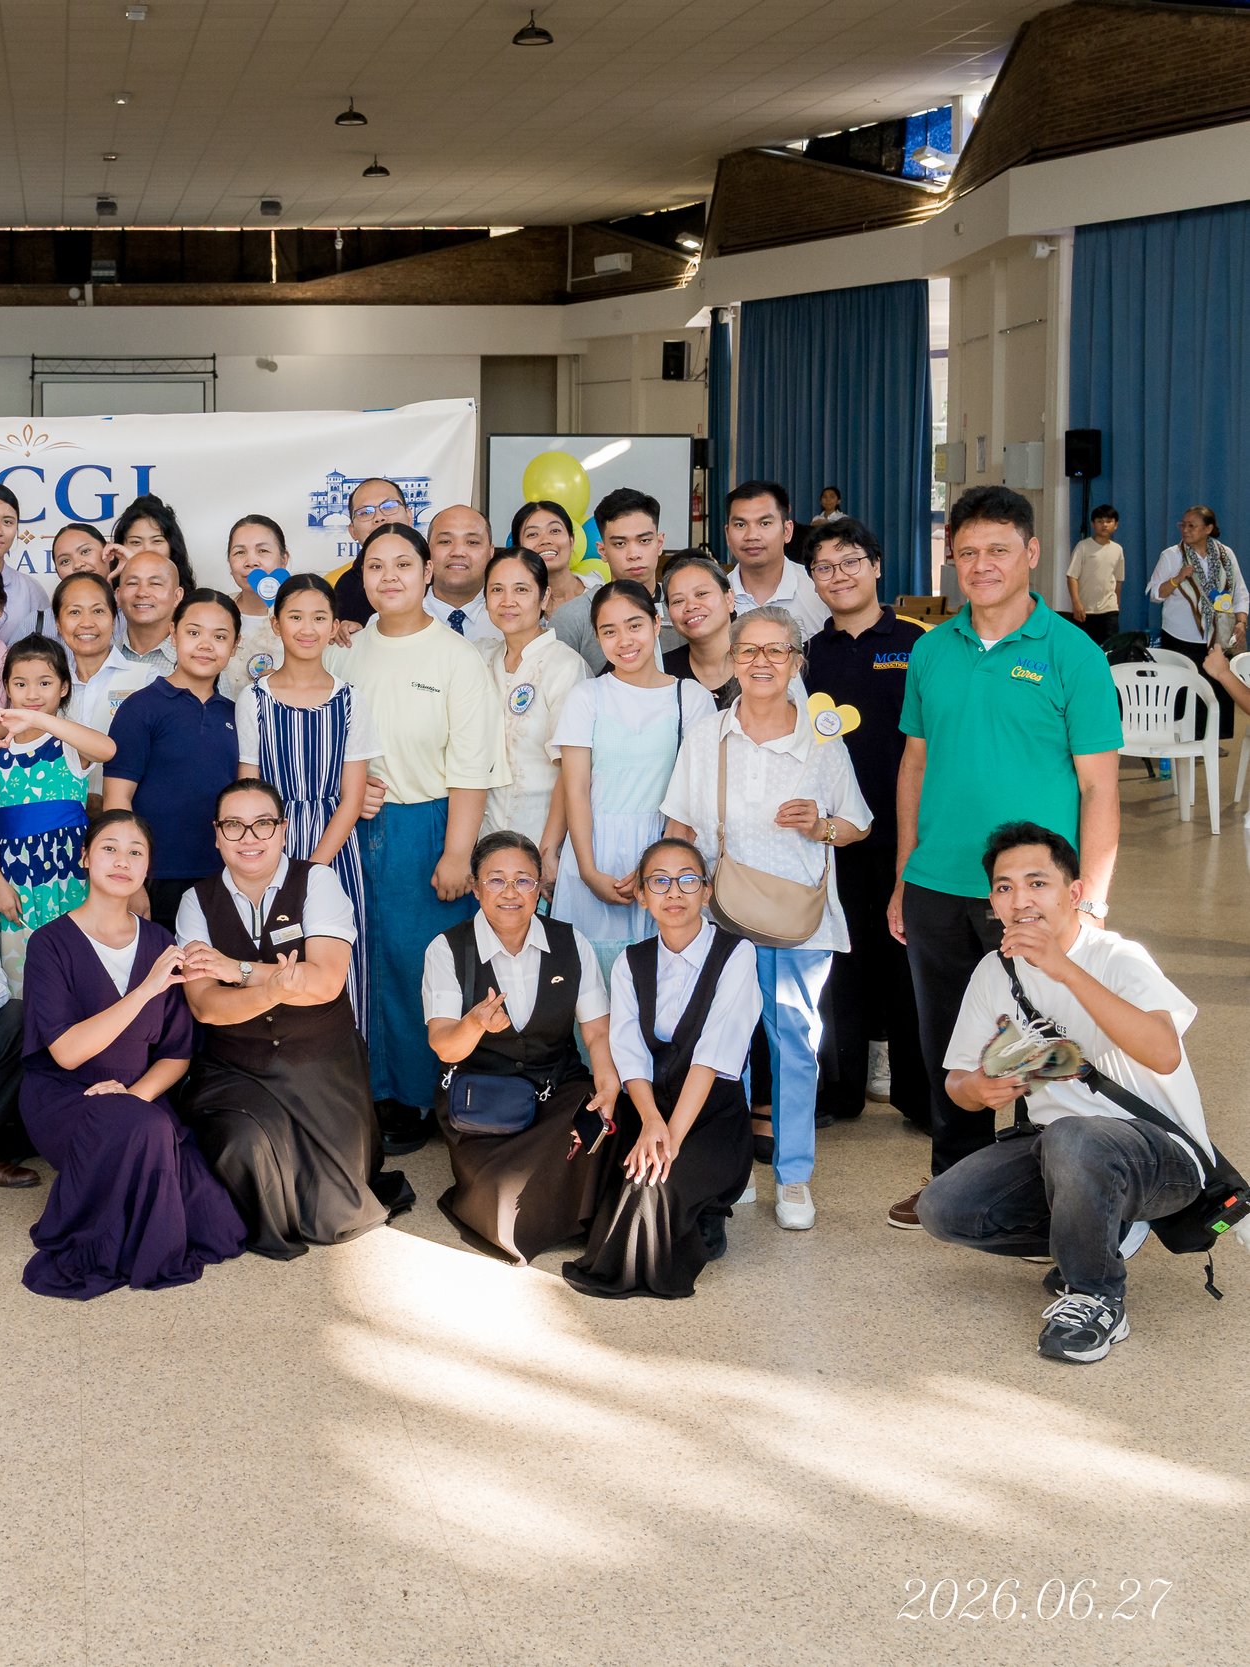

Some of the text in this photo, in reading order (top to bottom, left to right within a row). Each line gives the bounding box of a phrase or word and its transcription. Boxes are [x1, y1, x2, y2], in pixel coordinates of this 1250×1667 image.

[873, 660, 909, 670] PRODUCTION
[1016, 656, 1048, 672] MCGI
[1011, 665, 1044, 682] Cares
